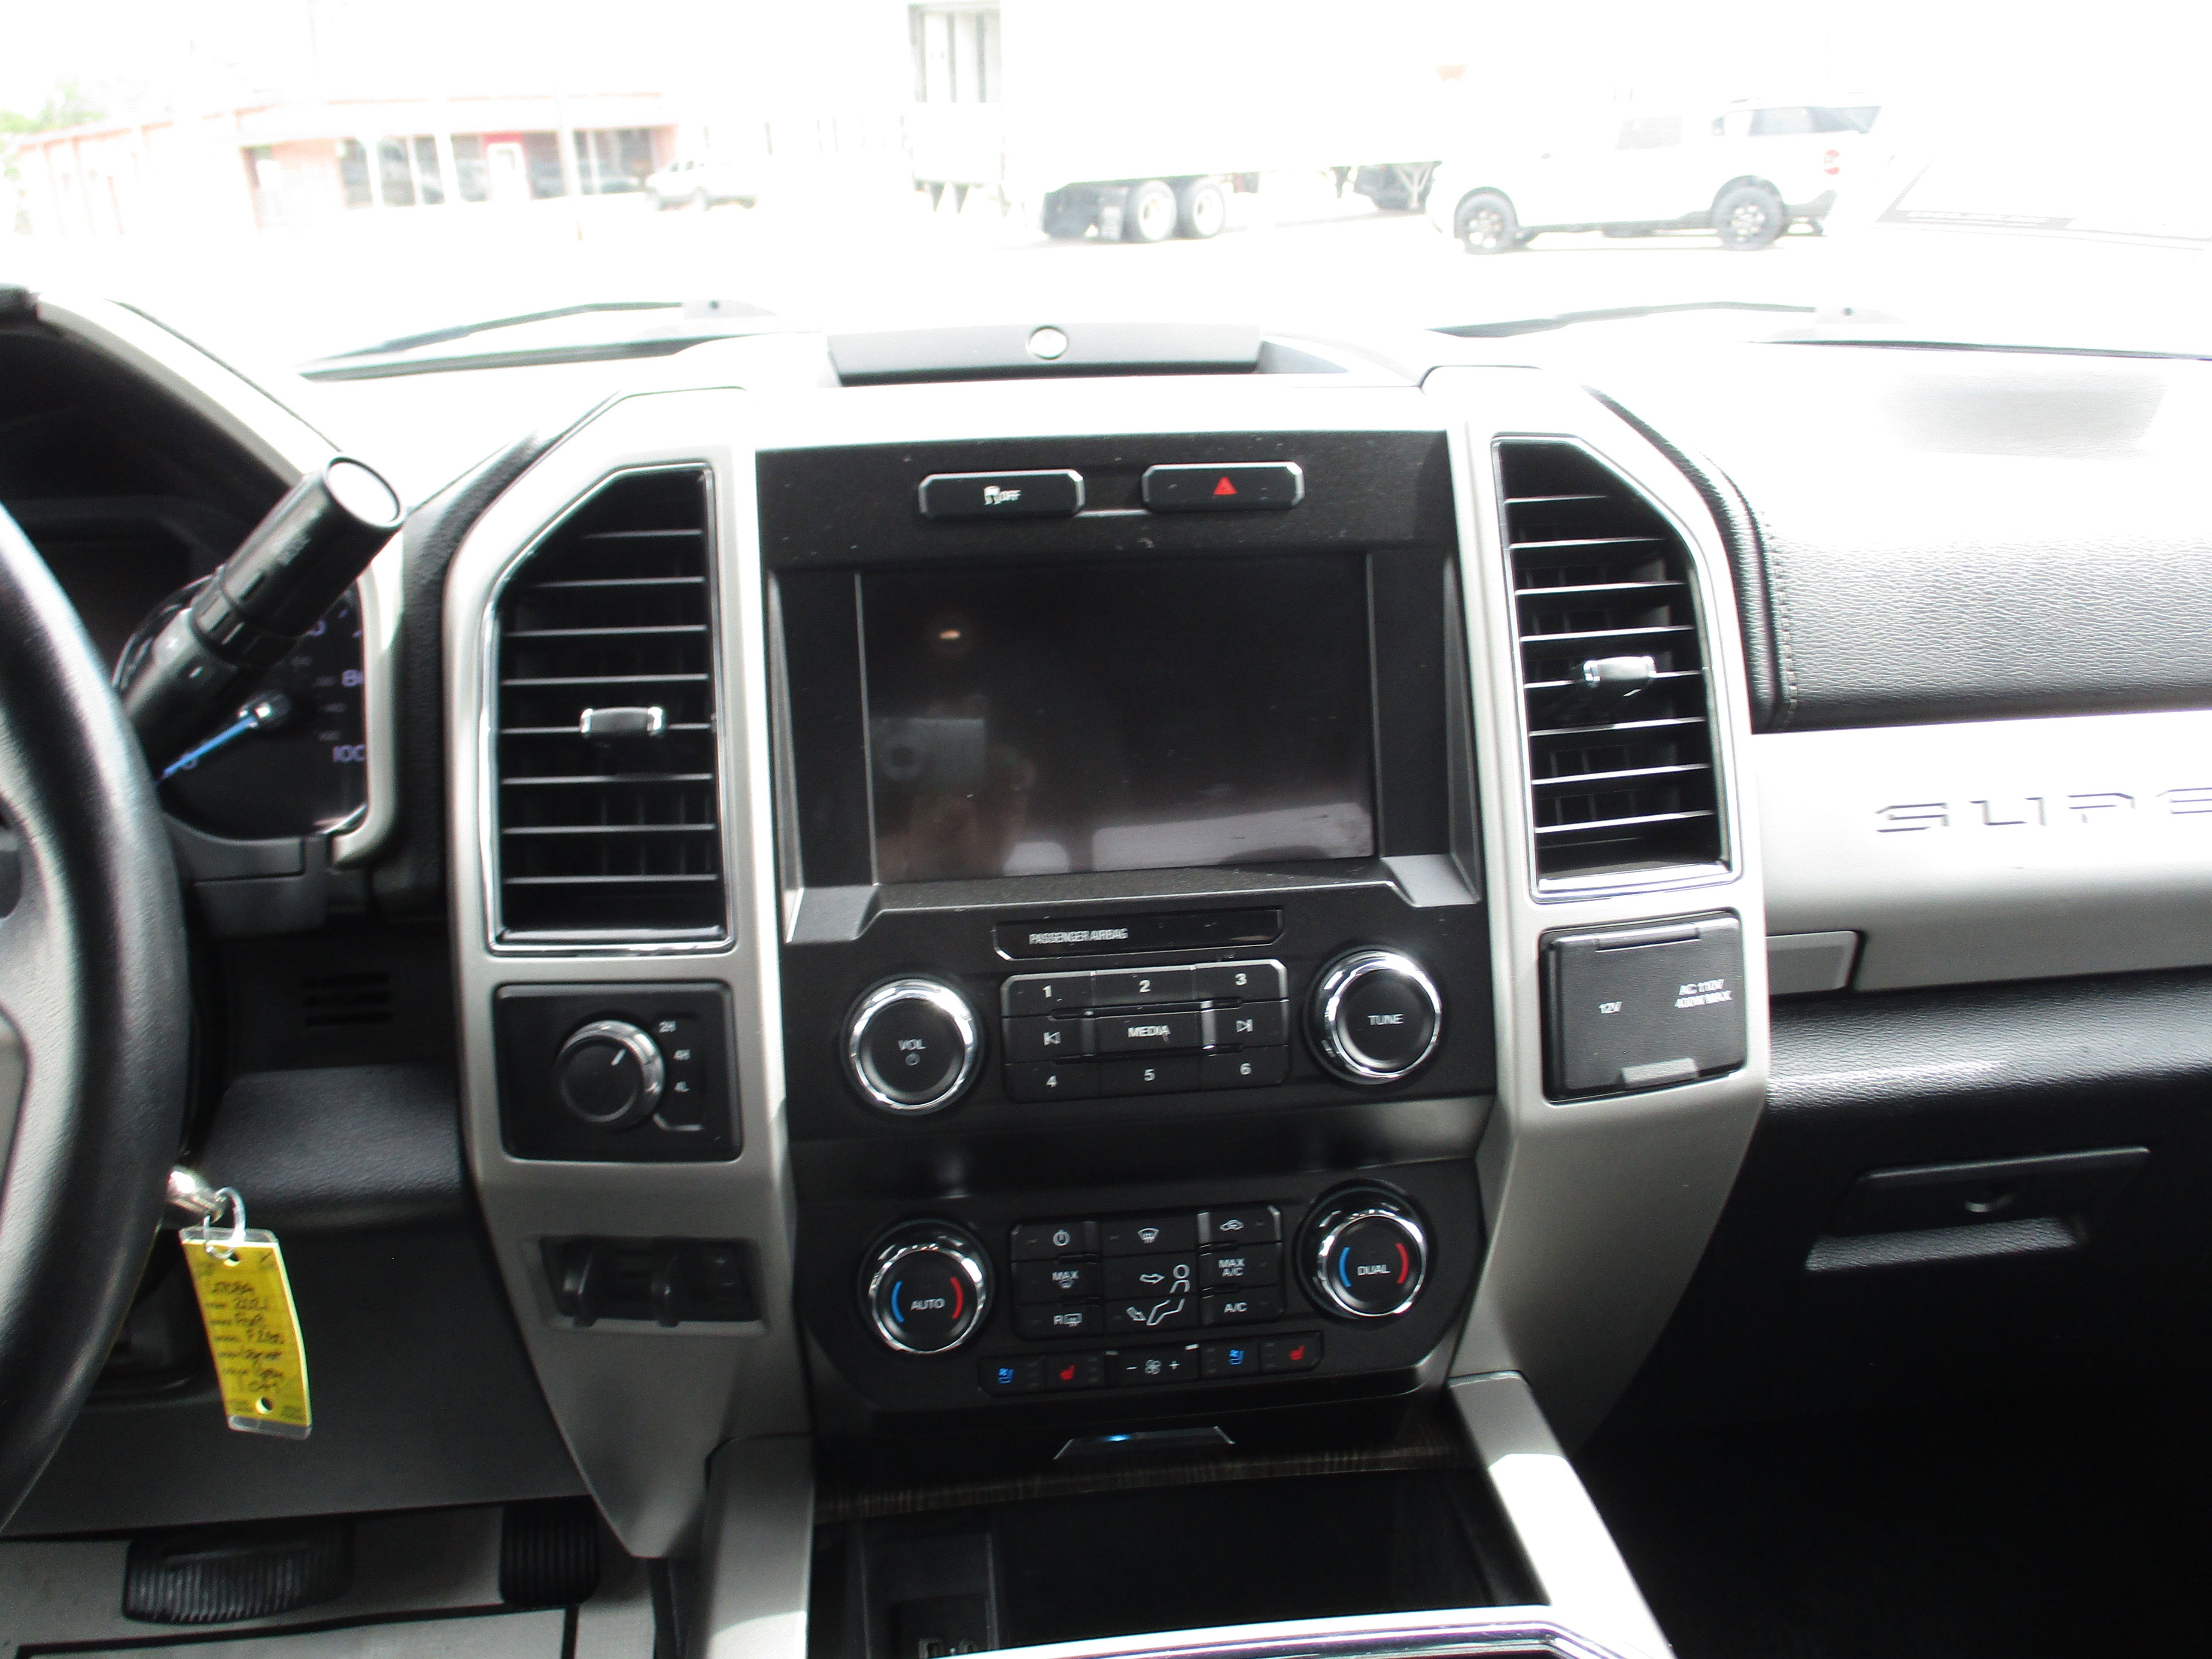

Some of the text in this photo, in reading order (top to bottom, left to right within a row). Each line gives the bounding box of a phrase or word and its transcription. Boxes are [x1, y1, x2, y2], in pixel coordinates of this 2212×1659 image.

[1000, 490, 1021, 501] OFF
[1029, 928, 1129, 945] PASSENGER AIRBAG
[1235, 972, 1248, 986] 3
[1042, 985, 1052, 998] 1
[1139, 979, 1151, 993] 2
[1678, 983, 1697, 996] AC
[1705, 990, 1733, 1005] MAX
[1367, 1013, 1404, 1026] TUNE
[1127, 1024, 1171, 1038] MEDIA
[897, 1039, 927, 1051] VOL
[1144, 1069, 1156, 1082] 5
[1240, 1063, 1252, 1075] 6
[1045, 1075, 1058, 1088] 4
[1218, 1258, 1245, 1269] MAX
[1357, 1264, 1391, 1276] DUAL
[1052, 1270, 1080, 1282] MAX
[1221, 1267, 1244, 1278] A/C
[910, 1297, 946, 1311] AUTO
[1224, 1302, 1248, 1313] A/C
[1053, 1315, 1063, 1326] R
